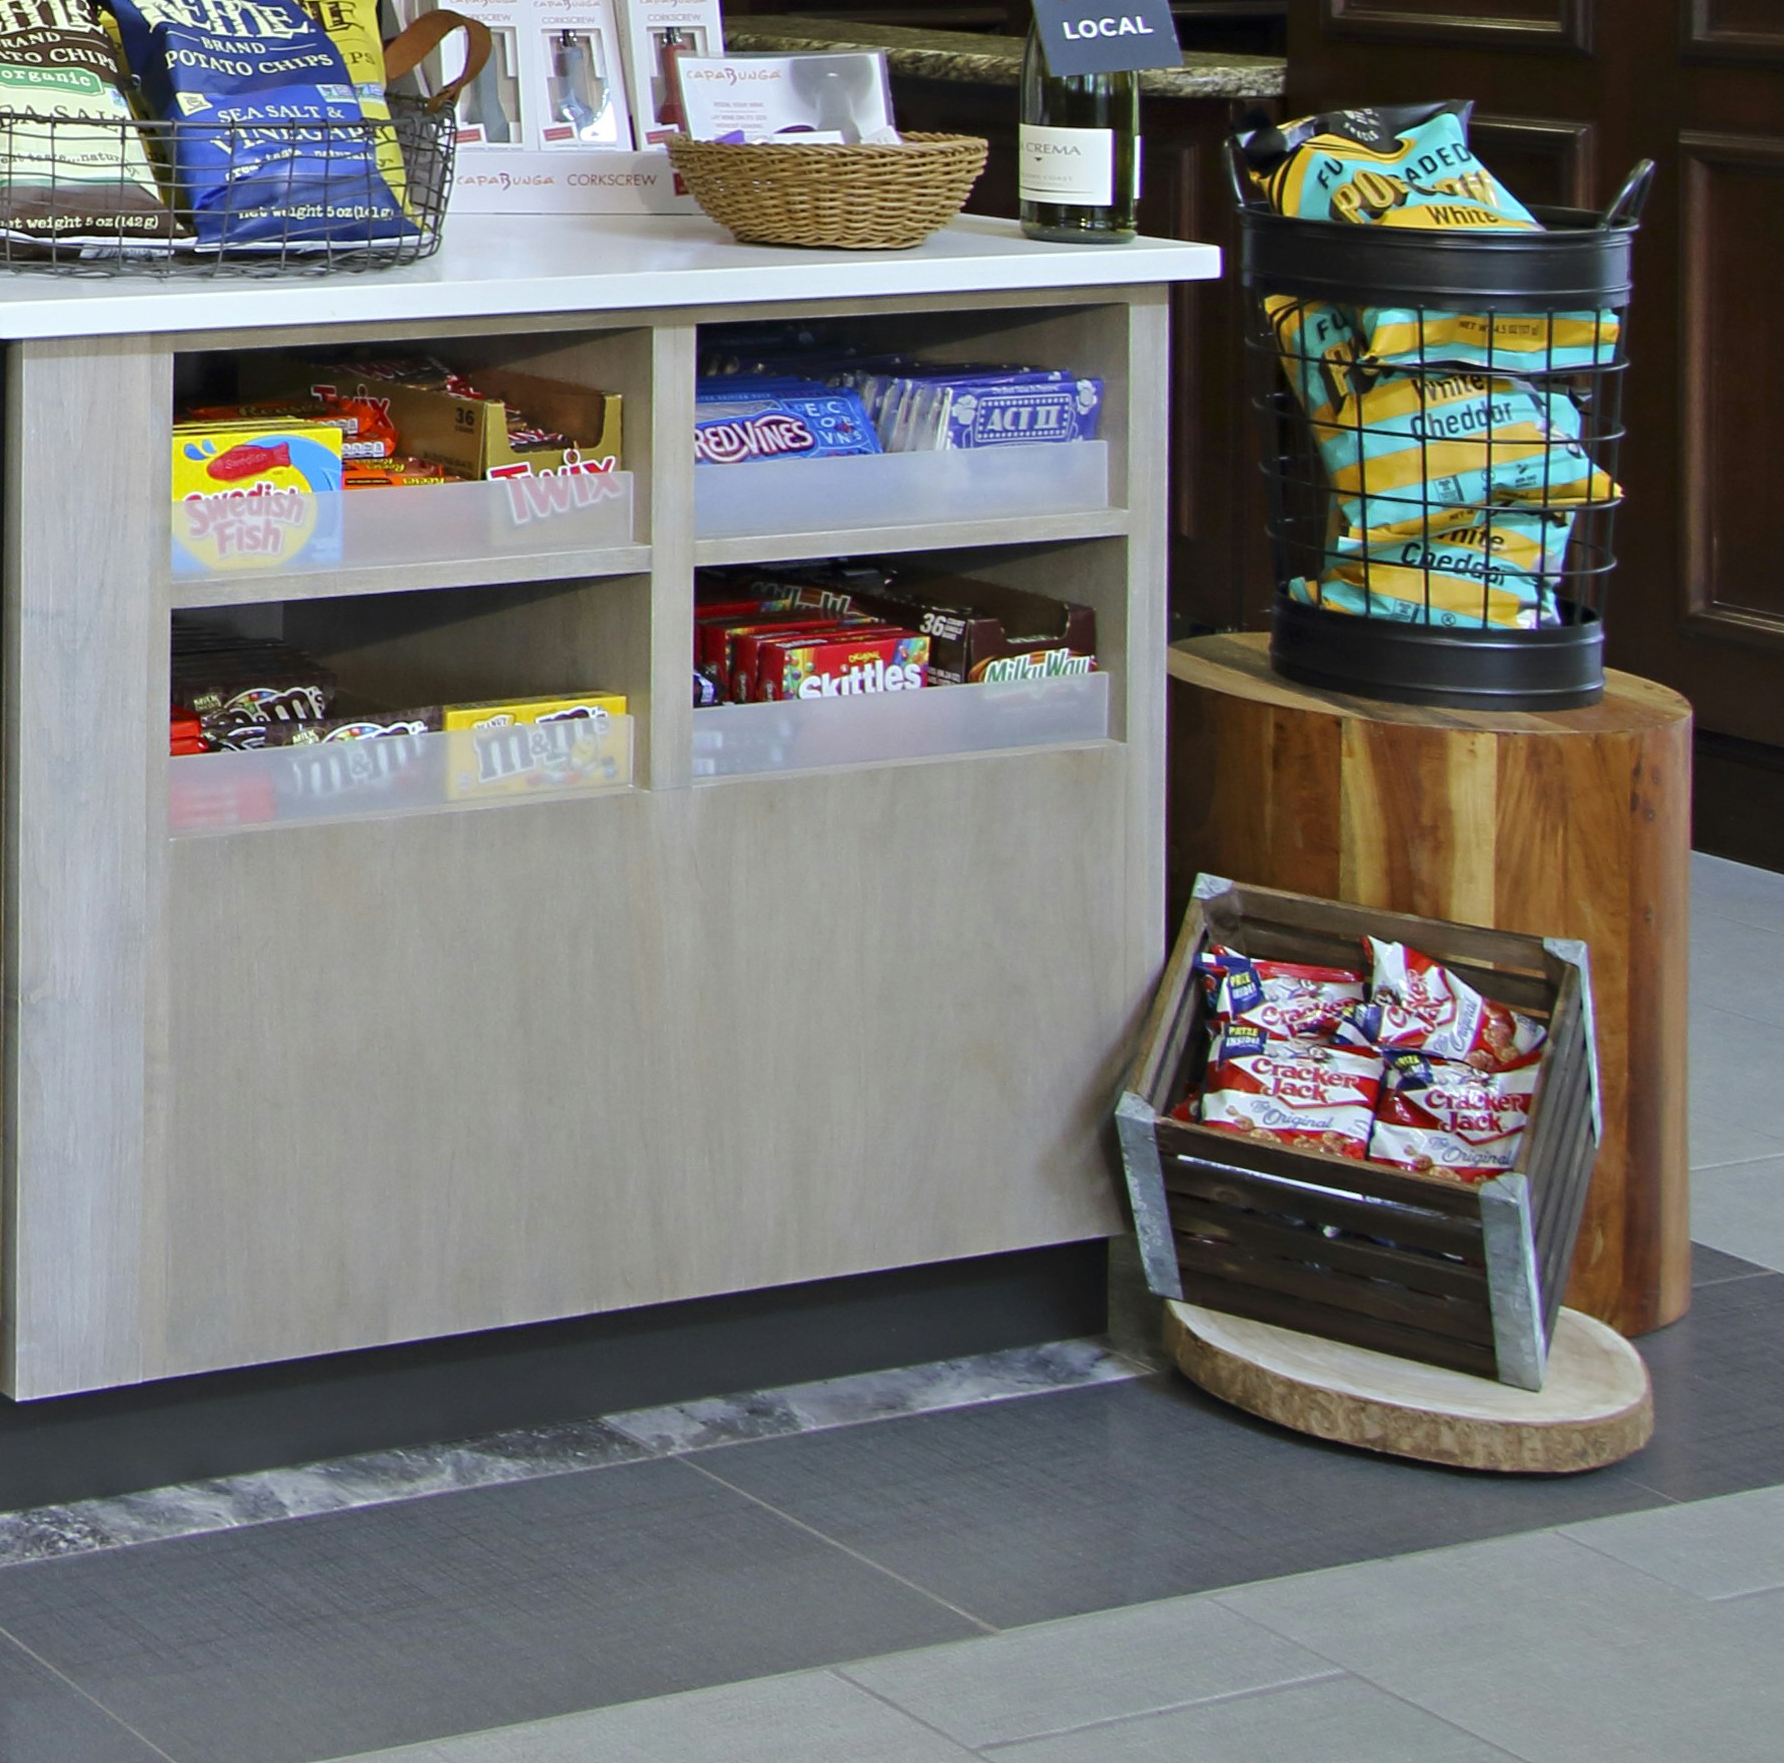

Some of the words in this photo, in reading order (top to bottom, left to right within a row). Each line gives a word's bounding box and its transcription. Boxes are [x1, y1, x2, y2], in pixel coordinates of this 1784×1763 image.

[542, 16, 595, 24] CORKSCREW
[648, 14, 701, 22] CORKSCREW
[1063, 15, 1154, 40] LOCAL
[201, 36, 267, 54] BRAND
[50, 47, 119, 74] CHIPS
[165, 49, 254, 76] POTATO
[258, 53, 334, 75] CHIPS
[0, 68, 92, 90] organic
[217, 104, 263, 124] SEA
[265, 104, 321, 119] SALT
[327, 105, 344, 119] &
[1025, 142, 1081, 157] CREMA
[567, 173, 657, 186] CORKSCREW
[25, 215, 83, 231] weight
[1426, 204, 1499, 225] White
[455, 407, 475, 428] 36
[987, 406, 1029, 433] ACT
[1033, 403, 1061, 430] II
[1410, 401, 1513, 442] Cheddar
[183, 481, 307, 539] Swedish
[214, 520, 284, 558] Fish
[920, 612, 947, 635] 36
[798, 659, 925, 701] Skittles
[1228, 1025, 1259, 1038] PRIZE
[1451, 997, 1479, 1052] Original
[1251, 1058, 1359, 1090] Cracker
[1263, 1076, 1330, 1104] Jack
[1424, 1089, 1526, 1114] Cracker
[1262, 1103, 1334, 1130] Original
[1438, 1110, 1505, 1134] Jack
[1441, 1140, 1513, 1167] Original
